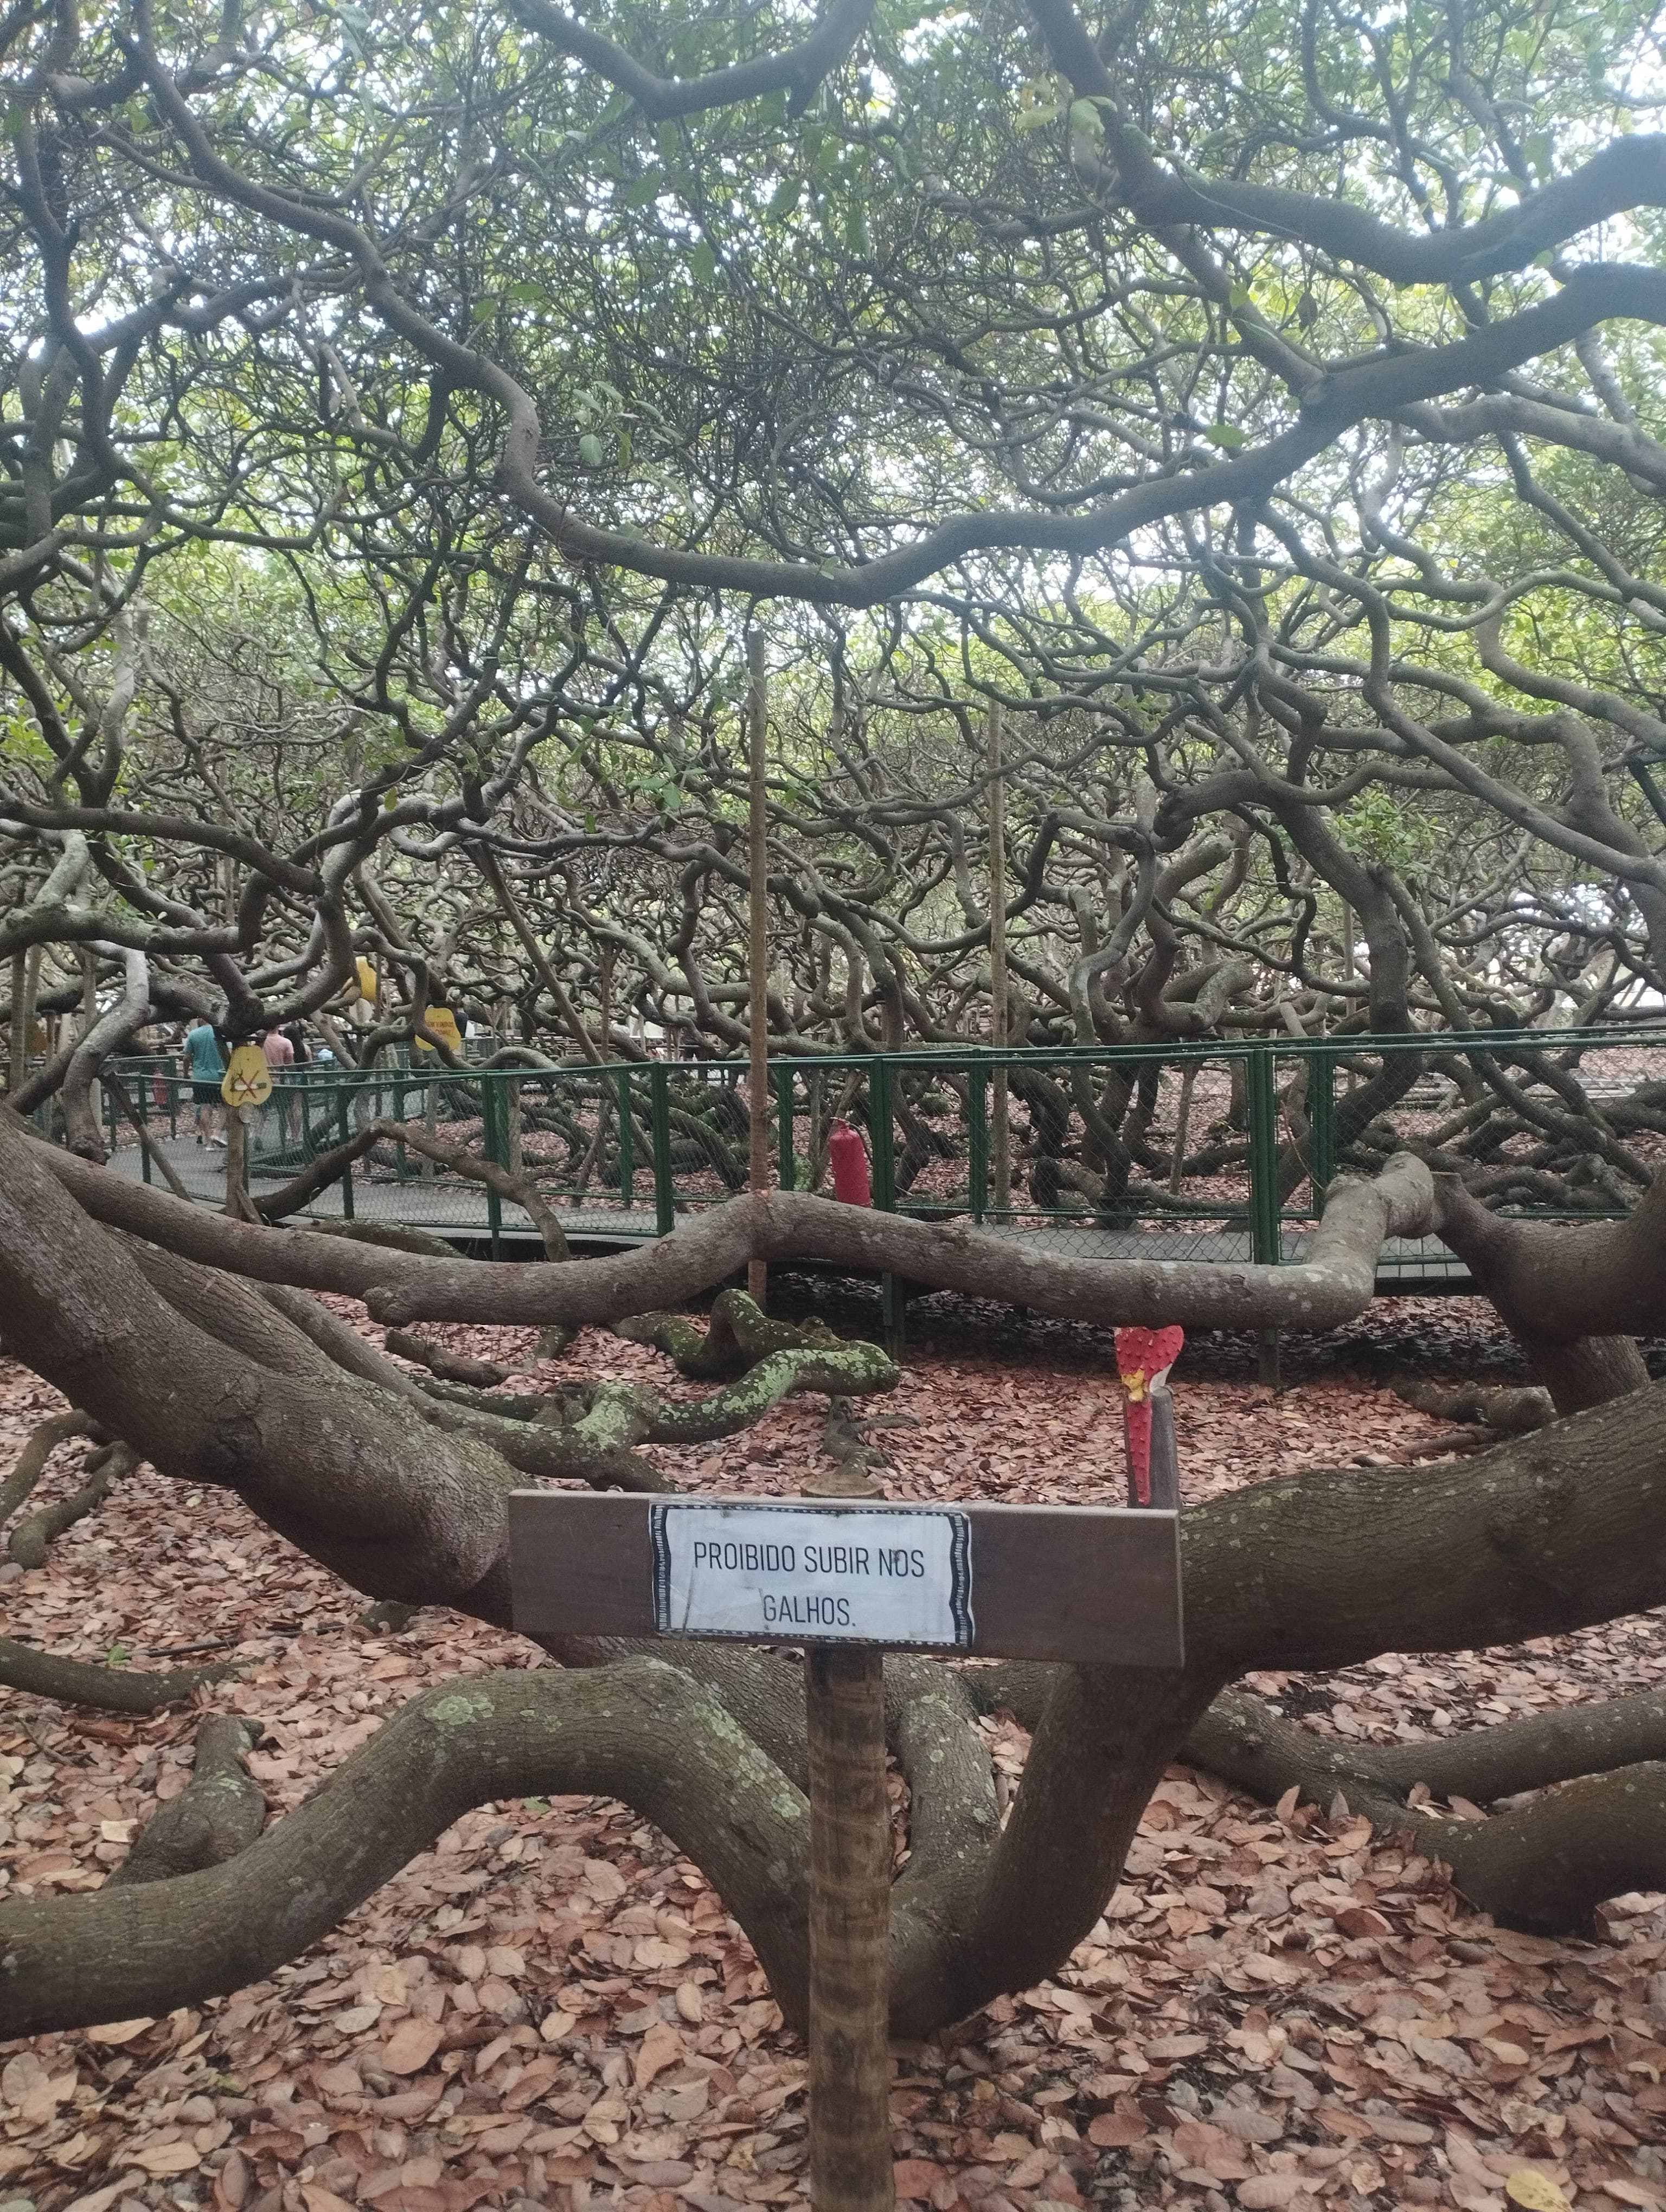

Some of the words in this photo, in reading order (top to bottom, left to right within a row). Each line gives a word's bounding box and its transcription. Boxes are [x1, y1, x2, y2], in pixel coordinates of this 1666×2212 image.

[694, 1541, 796, 1572] PROIBIDO
[804, 1546, 870, 1575] SUBIR
[879, 1548, 925, 1578] NOS
[763, 1594, 856, 1627] GALHOS.
